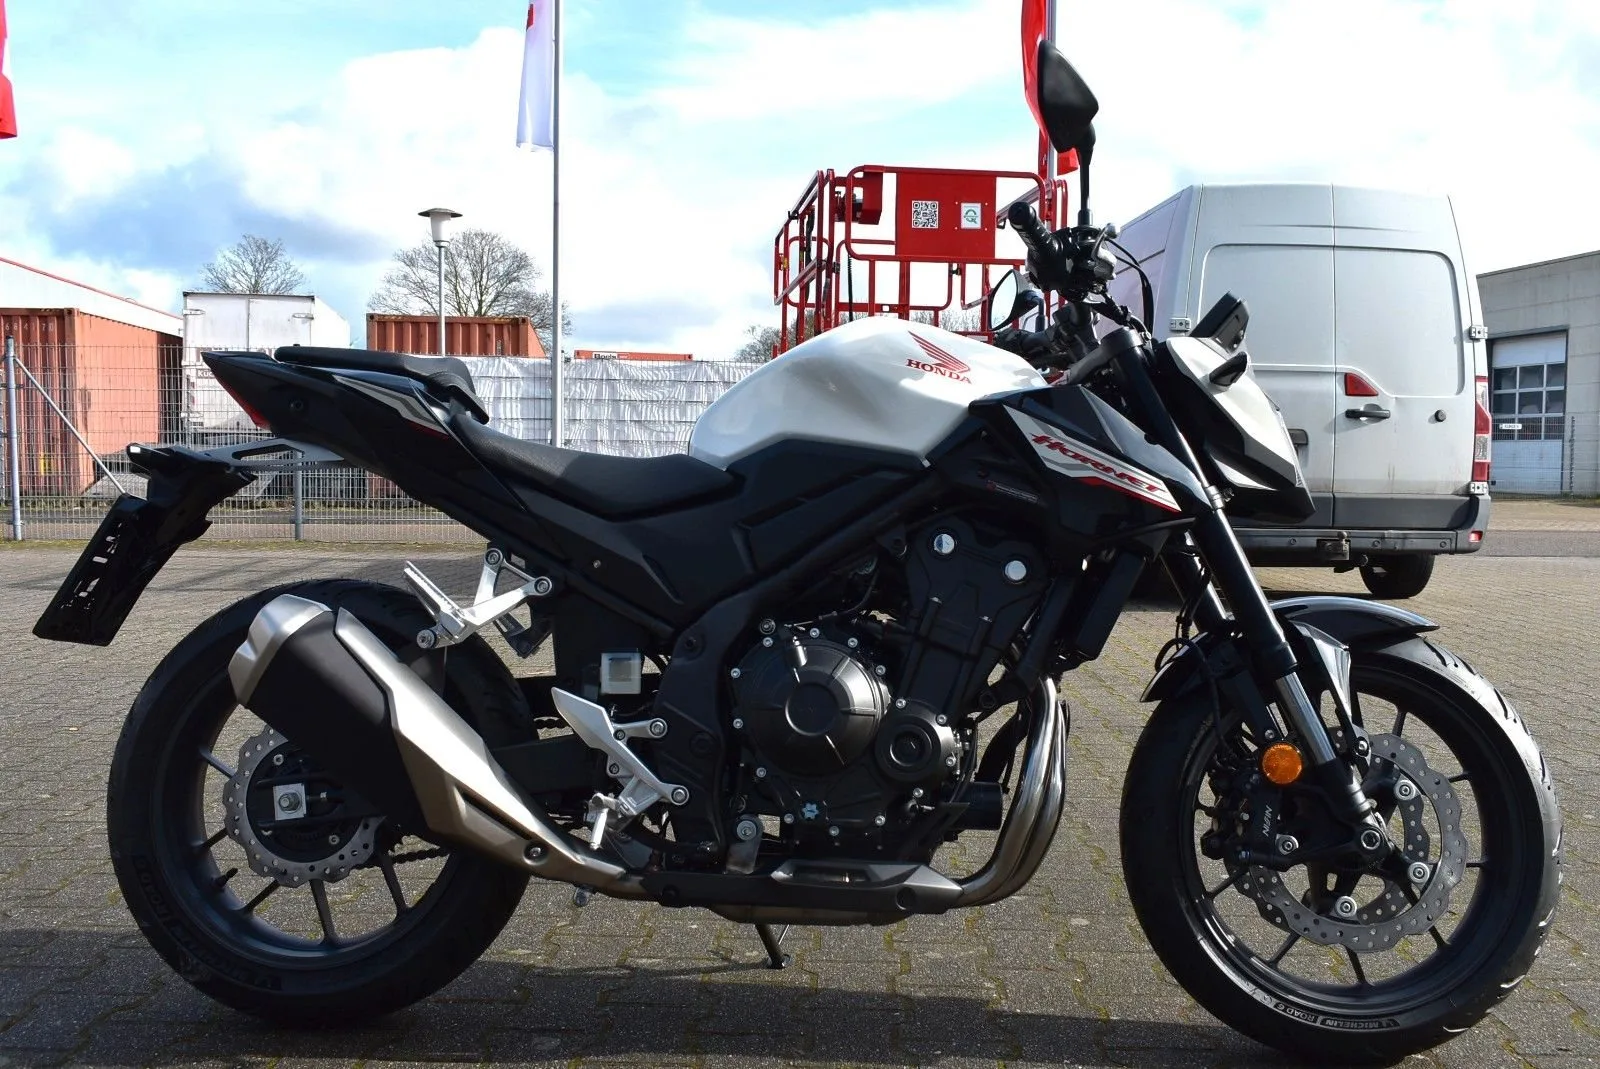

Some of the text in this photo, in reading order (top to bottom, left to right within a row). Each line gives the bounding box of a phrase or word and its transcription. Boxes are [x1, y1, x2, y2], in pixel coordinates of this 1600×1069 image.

[906, 359, 972, 385] HONDA
[1286, 1008, 1315, 1023] ROAD
[1325, 1019, 1379, 1029] MICHELIN
